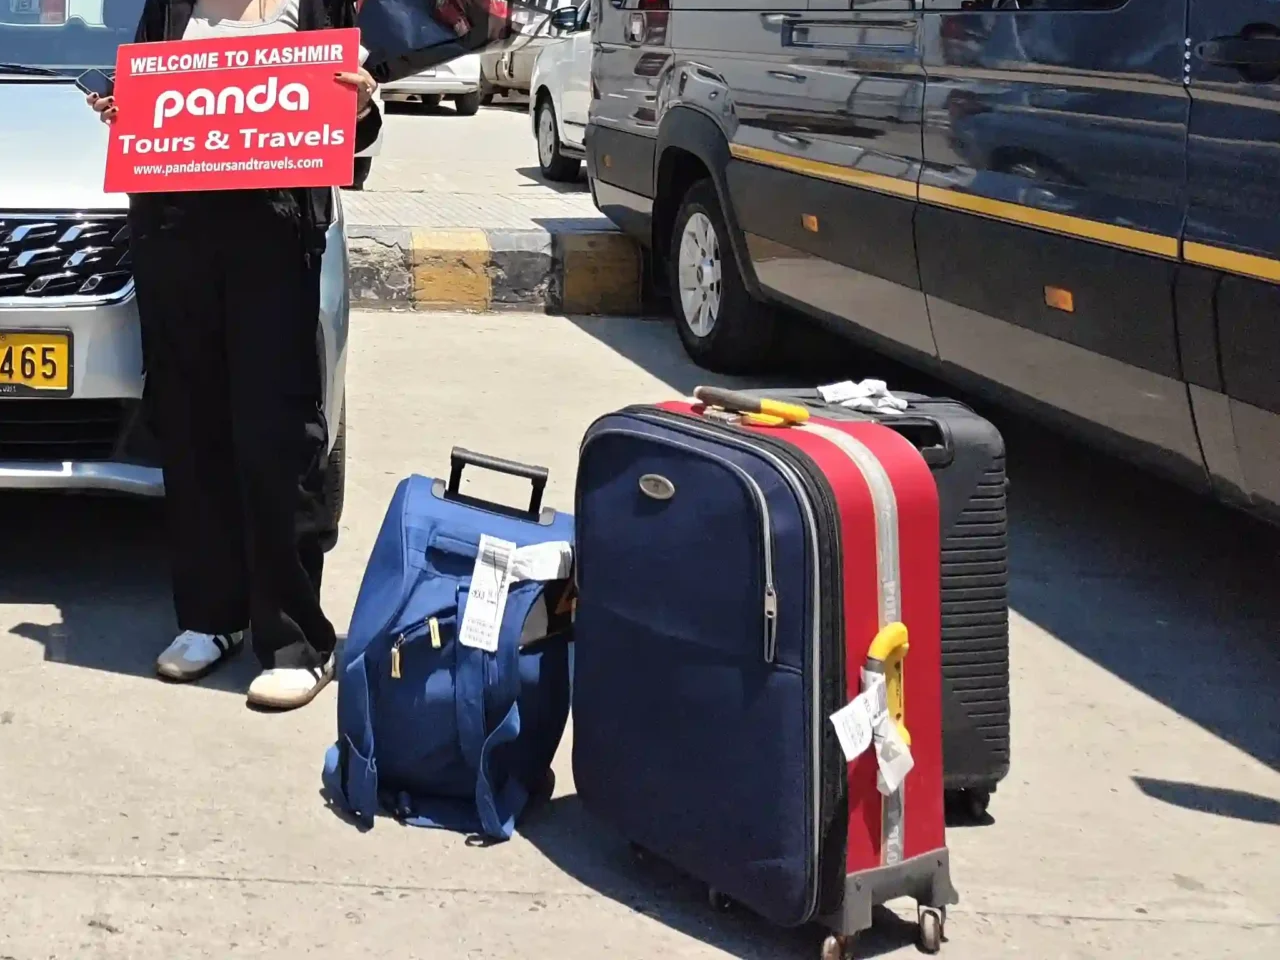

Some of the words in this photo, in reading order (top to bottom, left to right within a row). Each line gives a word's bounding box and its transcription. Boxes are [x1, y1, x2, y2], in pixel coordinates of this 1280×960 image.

[130, 52, 219, 73] WELCOME
[225, 50, 249, 67] TO
[255, 44, 343, 65] KASHMIR
[153, 77, 310, 128] panda
[118, 134, 196, 155] Tours
[204, 130, 230, 151] &
[239, 124, 345, 149] Travels
[133, 157, 324, 176] www.pandatoursandtravels.com
